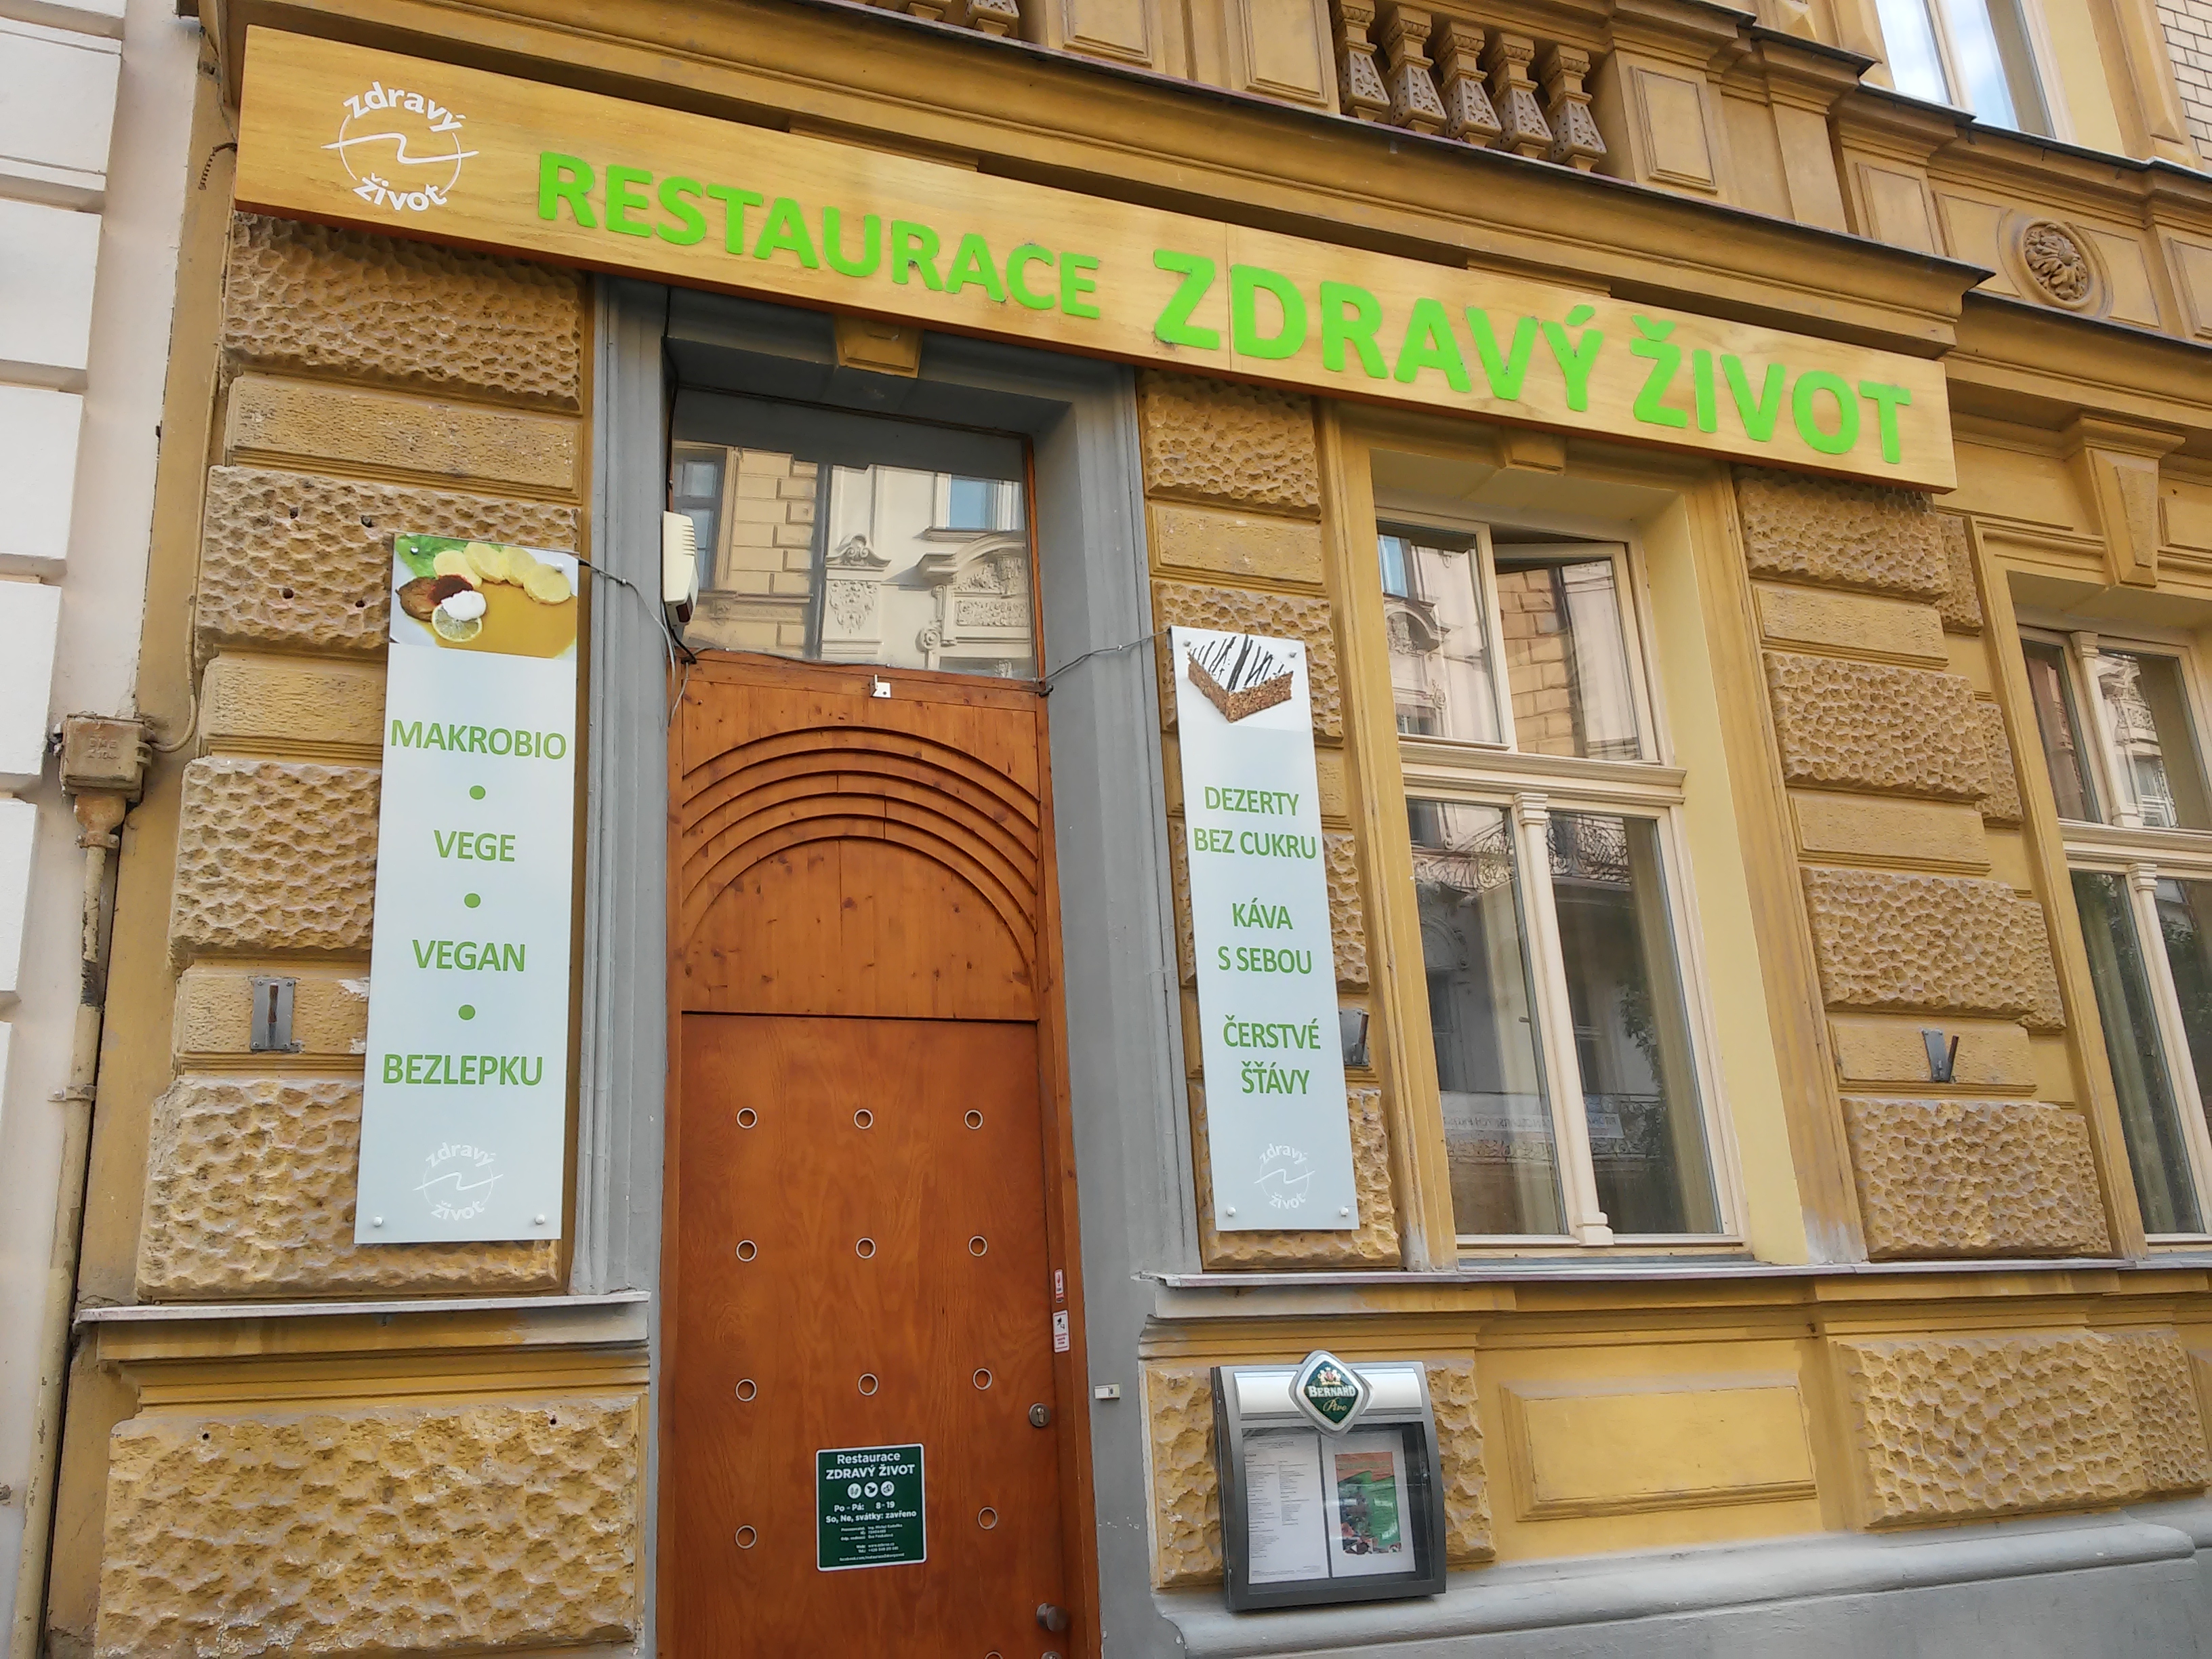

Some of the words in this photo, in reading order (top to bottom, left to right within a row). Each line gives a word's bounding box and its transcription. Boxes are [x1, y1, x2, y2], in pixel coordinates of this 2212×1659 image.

[343, 81, 466, 132] zdravý
[352, 172, 447, 211] život
[538, 151, 1100, 319] RESTAURACE
[1153, 249, 1603, 412] ZDRAVÝ
[1630, 314, 1911, 464] ŽIVOT
[391, 720, 567, 760] MAKROBIO
[1205, 787, 1299, 815] DEZERTY
[434, 830, 516, 861] VEGE
[1193, 827, 1235, 853] BEZ
[1240, 832, 1316, 859] CUKRU
[1232, 897, 1293, 929] KÁVA
[412, 940, 525, 972] VEGAN
[1218, 946, 1231, 970] S
[1236, 947, 1312, 974] SEBOU
[1223, 1015, 1321, 1049] ČERSTVÉ
[383, 1054, 543, 1086] BEZLEPKU
[1241, 1061, 1310, 1094] ŠŤÁVY
[426, 1142, 496, 1168] zdravý
[1259, 1143, 1308, 1164] zdravý
[431, 1200, 485, 1221] život
[1269, 1191, 1307, 1210] život
[1307, 1385, 1355, 1397] BERNARD
[826, 1465, 876, 1480] ZDRAVÝ
[879, 1464, 916, 1476] ŽIVOT
[837, 1452, 901, 1464] Restaurace
[825, 1515, 839, 1523] So,
[855, 1512, 884, 1521] svátky:
[885, 1510, 917, 1518] zavřeno
[852, 1502, 865, 1511] Pá:
